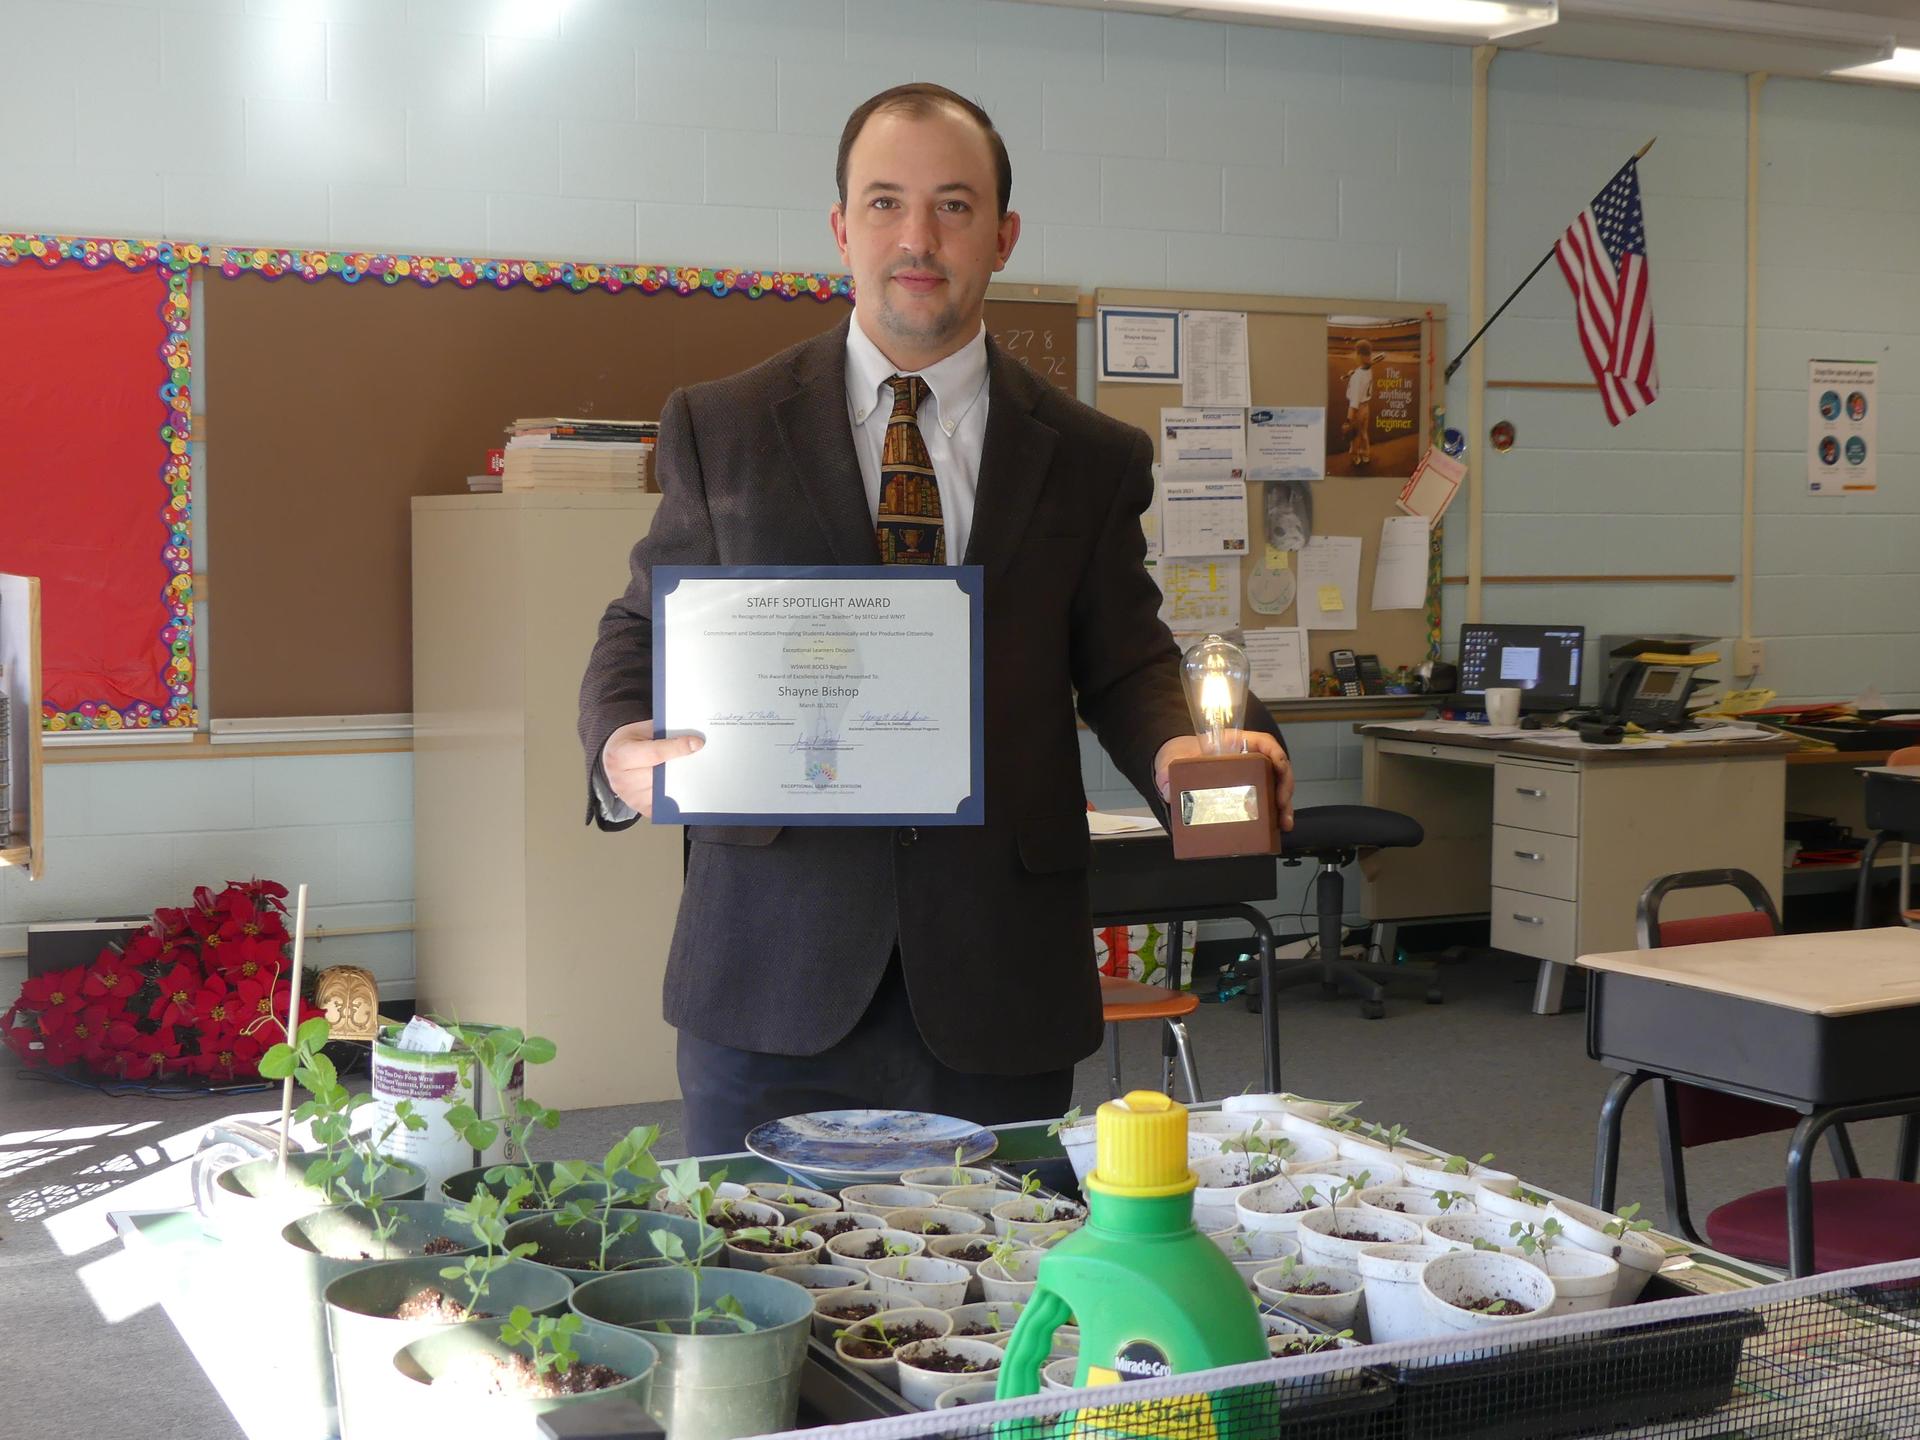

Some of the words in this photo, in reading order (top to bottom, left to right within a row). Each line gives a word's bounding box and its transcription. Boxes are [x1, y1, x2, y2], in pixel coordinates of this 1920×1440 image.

[1386, 368, 1400, 378] The
[1376, 378, 1402, 390] expert
[1404, 379, 1412, 388] in
[1378, 389, 1412, 404] anything
[1390, 400, 1404, 408] was
[1381, 408, 1400, 417] once
[747, 597, 780, 608] STAFF
[782, 597, 845, 608] SPOTLIGHT
[848, 597, 891, 608] AWARD
[778, 687, 818, 698] Shayne
[822, 687, 859, 698] Bishop
[1465, 711, 1482, 720] SAT
[1114, 1356, 1171, 1376] Miracle-Gro
